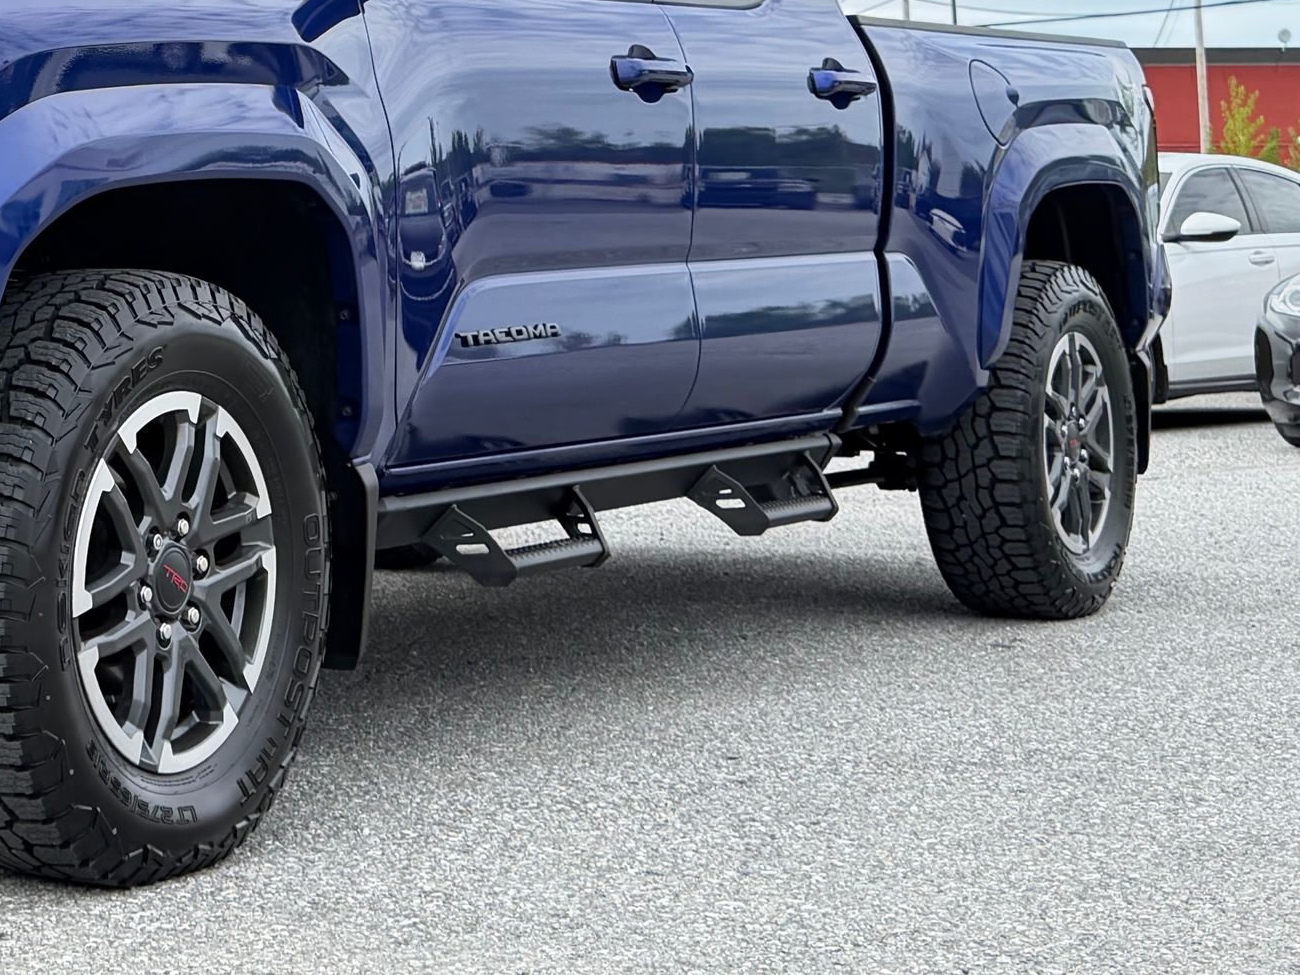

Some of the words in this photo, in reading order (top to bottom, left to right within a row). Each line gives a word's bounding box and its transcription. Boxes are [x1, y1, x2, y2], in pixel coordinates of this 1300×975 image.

[455, 322, 562, 348] TACOMA
[84, 344, 167, 452] TYRES
[163, 564, 189, 593] TRD
[277, 513, 322, 736] OUTPOST
